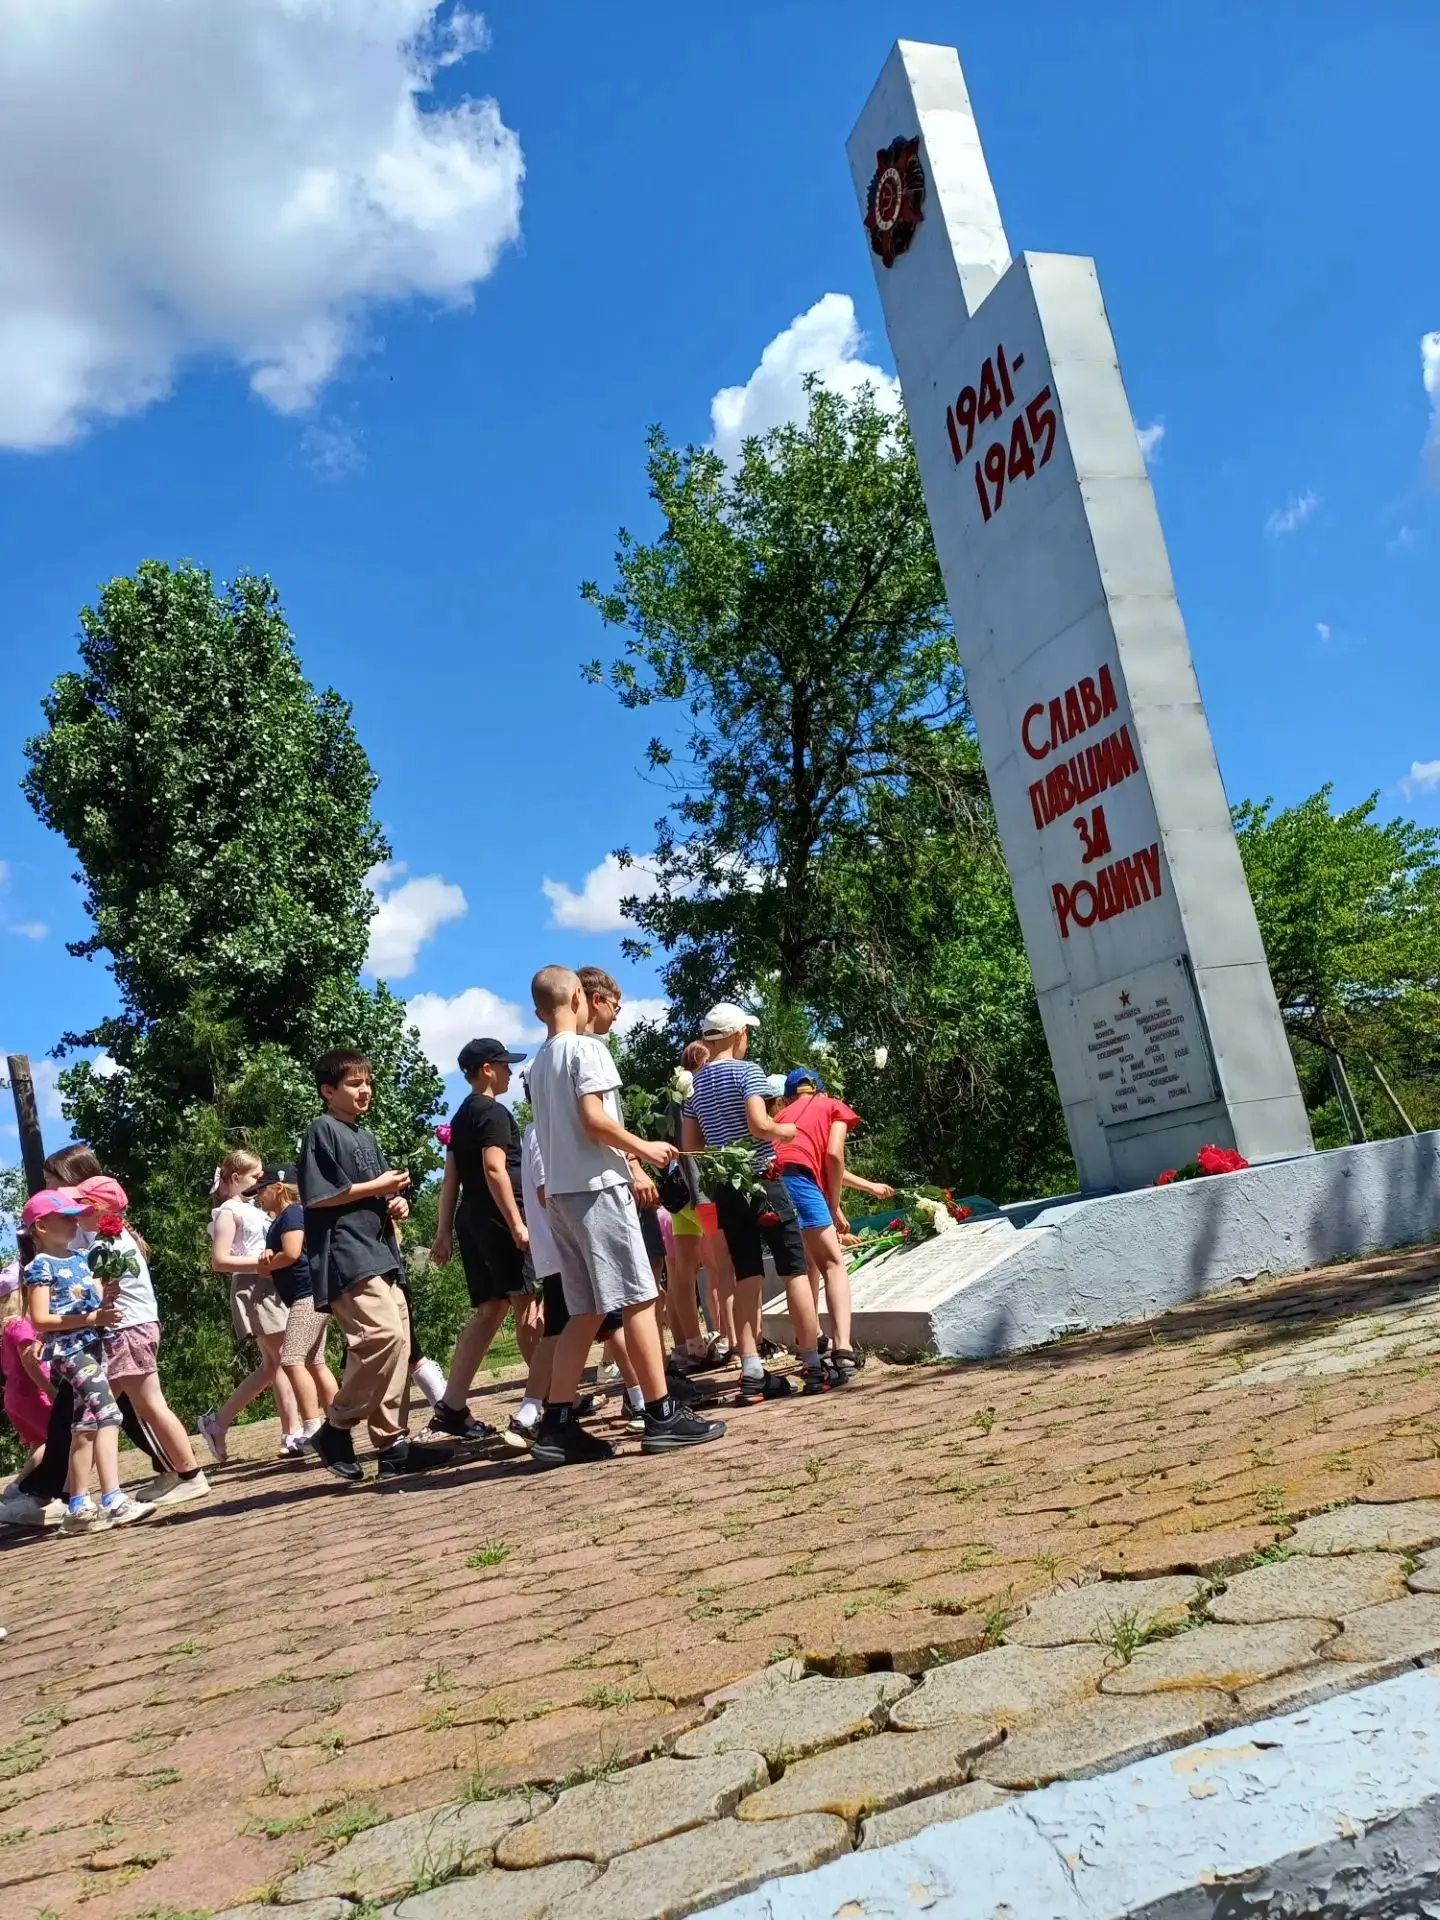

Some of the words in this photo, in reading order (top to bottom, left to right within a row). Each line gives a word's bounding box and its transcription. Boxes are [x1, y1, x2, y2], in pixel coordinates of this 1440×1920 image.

[947, 344, 1024, 465] 1941-
[975, 385, 1056, 524] 1945
[1022, 663, 1118, 760] СЛАВА
[1029, 724, 1139, 830] ПАВШИМ
[1073, 805, 1111, 864] ЗА
[1052, 843, 1162, 938] РОДИНУ
